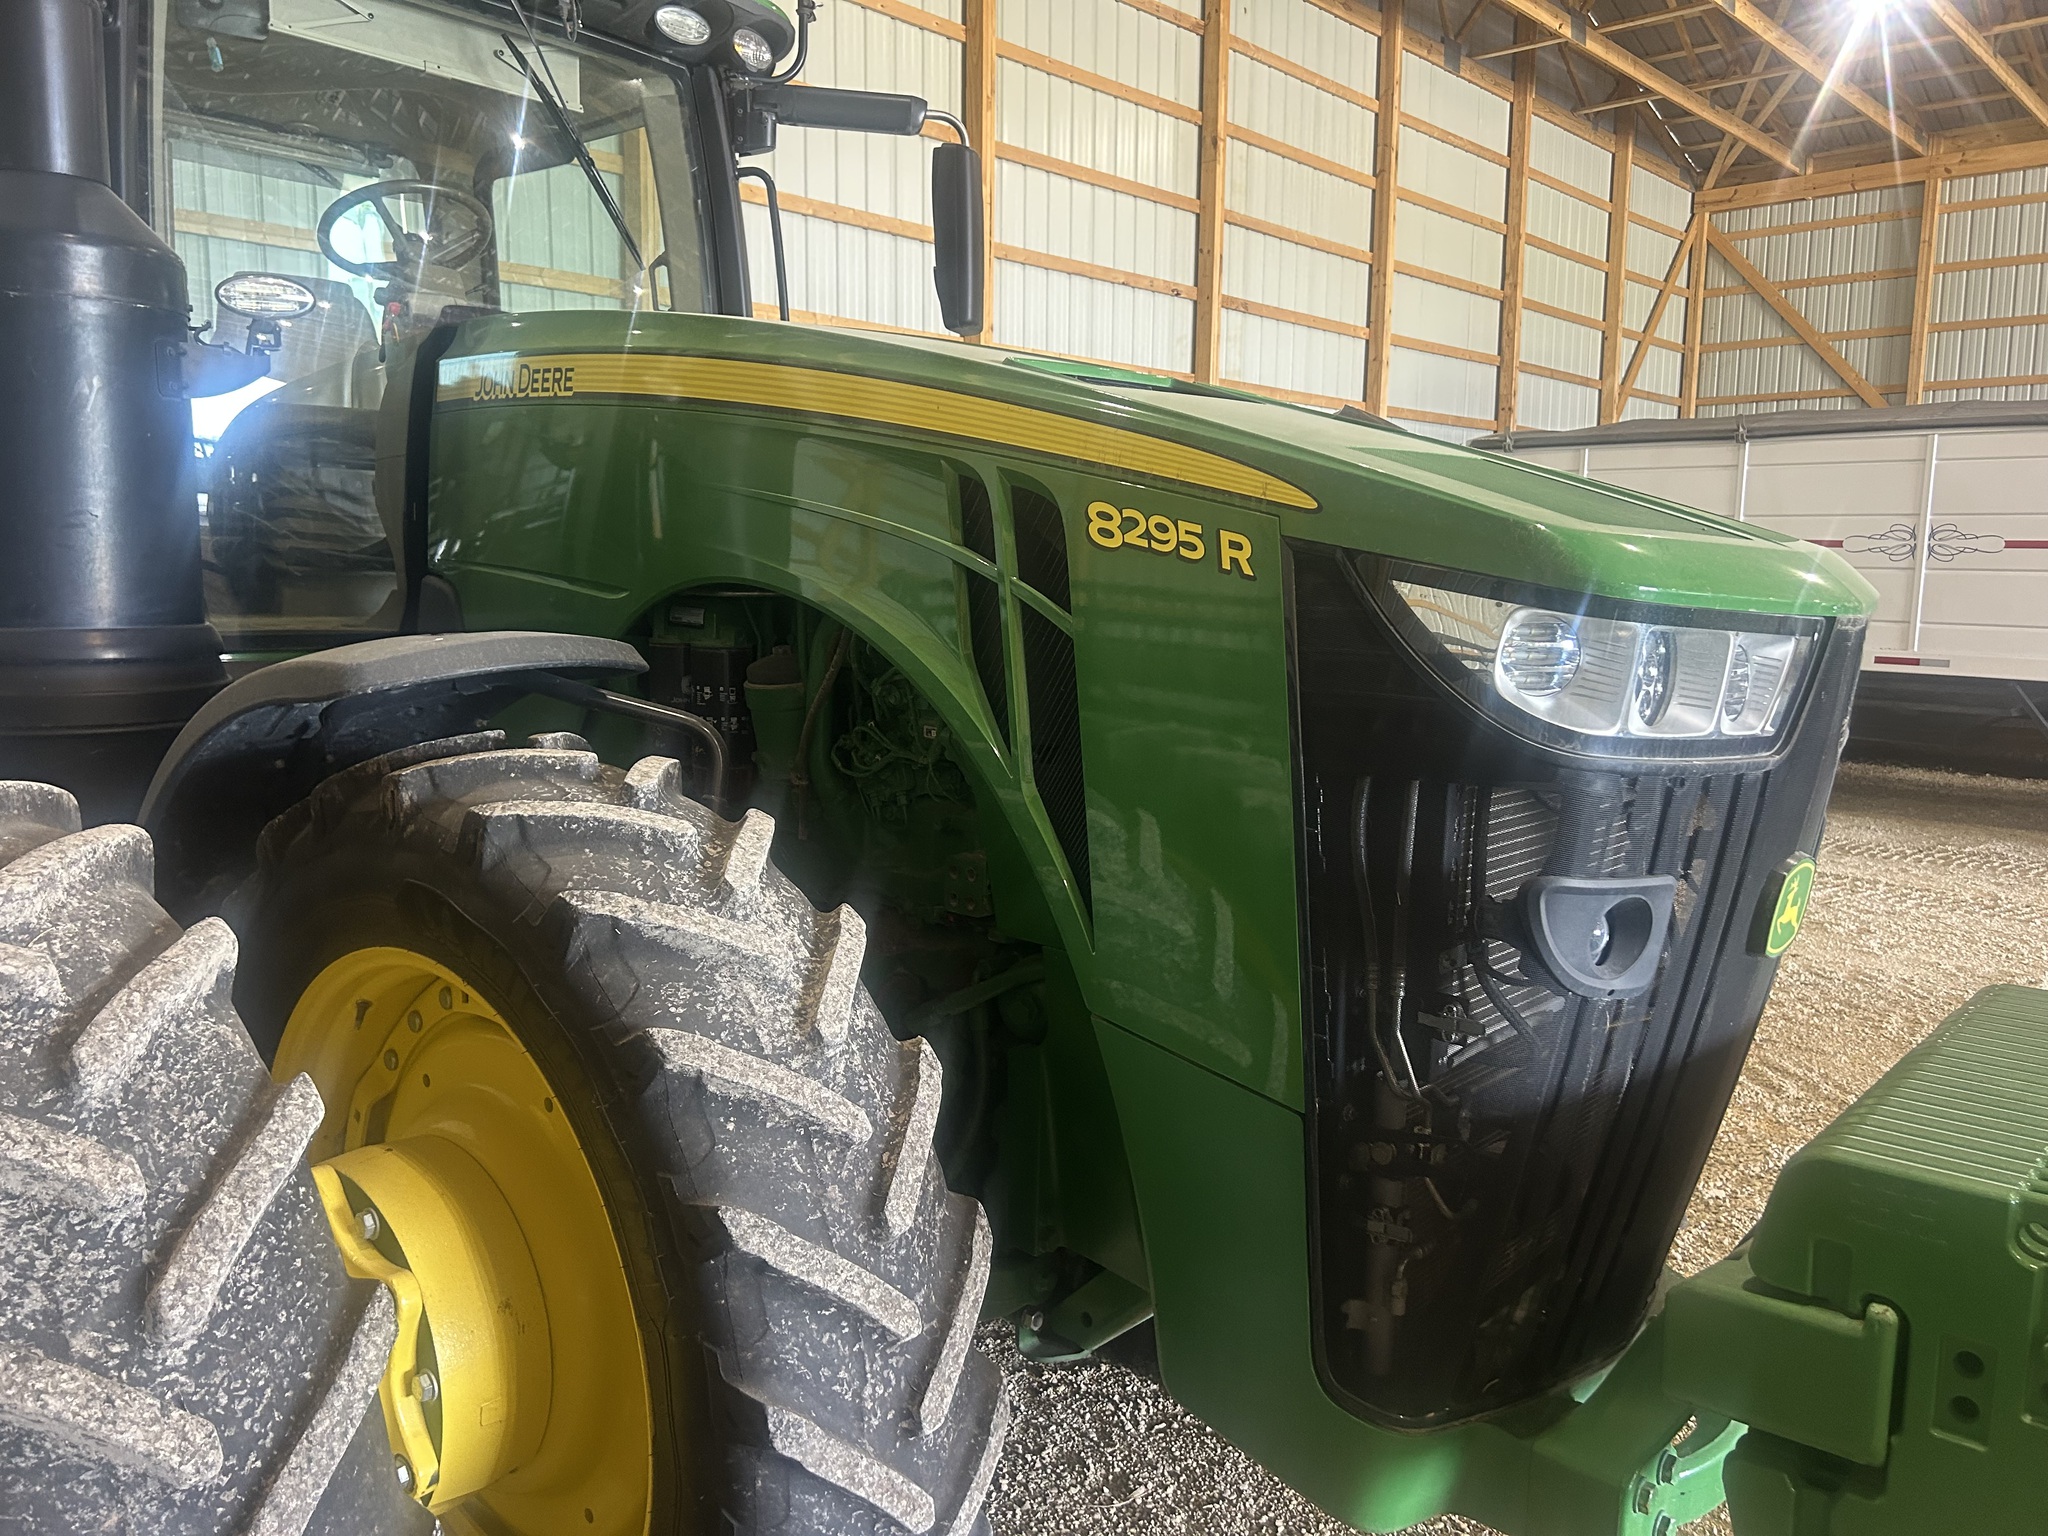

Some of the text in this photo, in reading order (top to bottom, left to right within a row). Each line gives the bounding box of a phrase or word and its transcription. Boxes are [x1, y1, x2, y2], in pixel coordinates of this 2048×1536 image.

[474, 363, 575, 398] JOHN DEERE
[1086, 500, 1255, 578] 8295 R
